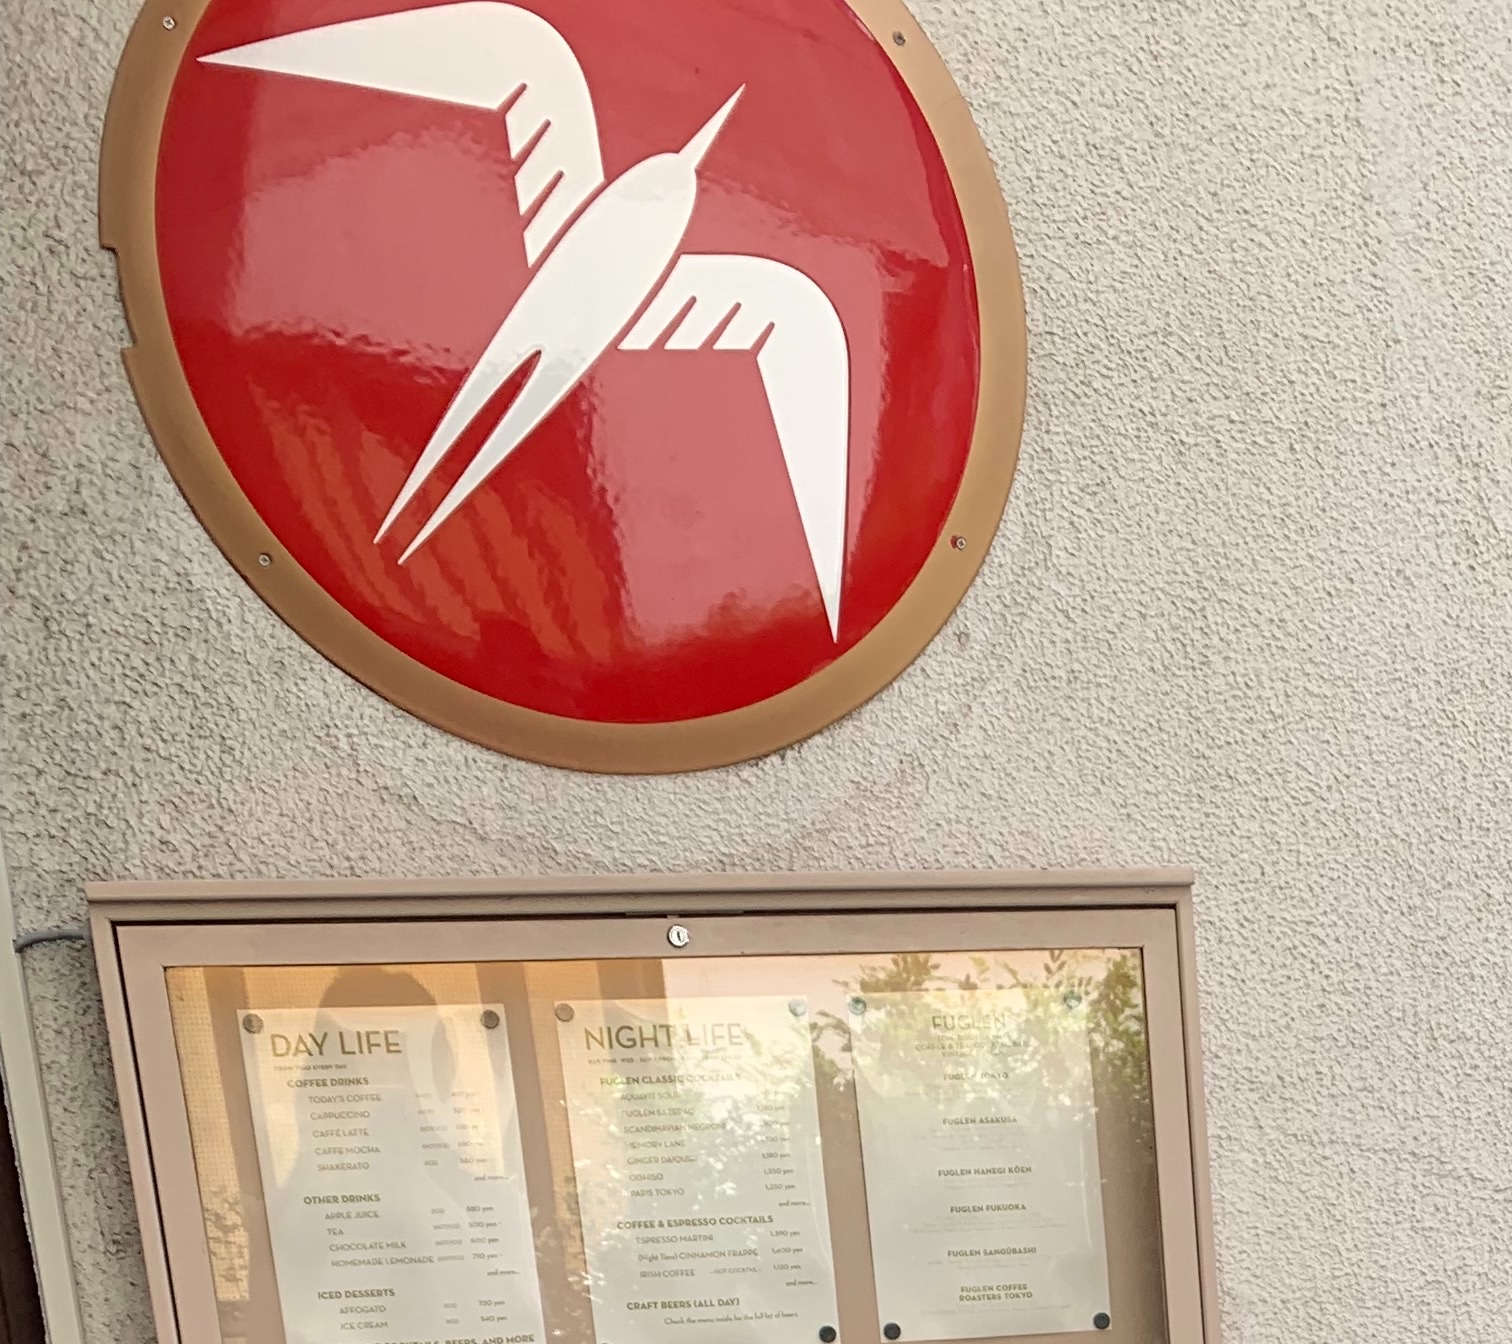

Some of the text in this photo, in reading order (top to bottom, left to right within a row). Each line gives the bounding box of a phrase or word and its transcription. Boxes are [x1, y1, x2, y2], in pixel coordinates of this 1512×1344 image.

[932, 1013, 1006, 1031] FUGLEN
[584, 1023, 744, 1051] NIGHT LIFE
[270, 1030, 402, 1057] DAY LIFE
[287, 1076, 369, 1088] COFFEE DRINKS
[642, 1075, 684, 1085] CLASSIC
[346, 1093, 382, 1102] COFFEE
[310, 1110, 370, 1120] CAPPUCCINO
[943, 1116, 1018, 1125] FUGLEN ASAKUSA
[342, 1128, 369, 1137] LATTE
[627, 1156, 660, 1165] GINGER
[938, 1169, 972, 1177] FUGLEN
[631, 1188, 686, 1198] PARIS TOKYO
[304, 1194, 381, 1205] OTHER DRINKS
[950, 1204, 1026, 1214] FUGLEN FUKUOKA
[325, 1210, 380, 1220] APPLE JUICE
[617, 1215, 774, 1230] COFFEE & ESPRESSO COCKTAILS
[327, 1228, 344, 1236] TEA
[636, 1234, 714, 1245] ESPRESSO MARTINI
[329, 1241, 407, 1252] CHOCOLATE MILK
[679, 1250, 726, 1260] CINNAMON
[331, 1258, 383, 1268] HOMEMADE
[385, 1256, 434, 1265] LEMONADE
[640, 1268, 696, 1279] IRISH COFFEE
[996, 1284, 1028, 1292] COFFEE
[318, 1288, 396, 1300] ICED DESSERTS
[959, 1291, 1033, 1302] ROASTERS TOKYO
[627, 1297, 740, 1311] CRAFT BEERS (ALL DAY)
[339, 1305, 387, 1315] AFFOGATO
[341, 1321, 389, 1330] ICE CREAM
[664, 1317, 686, 1325] Check
[506, 1334, 535, 1344] MORE
